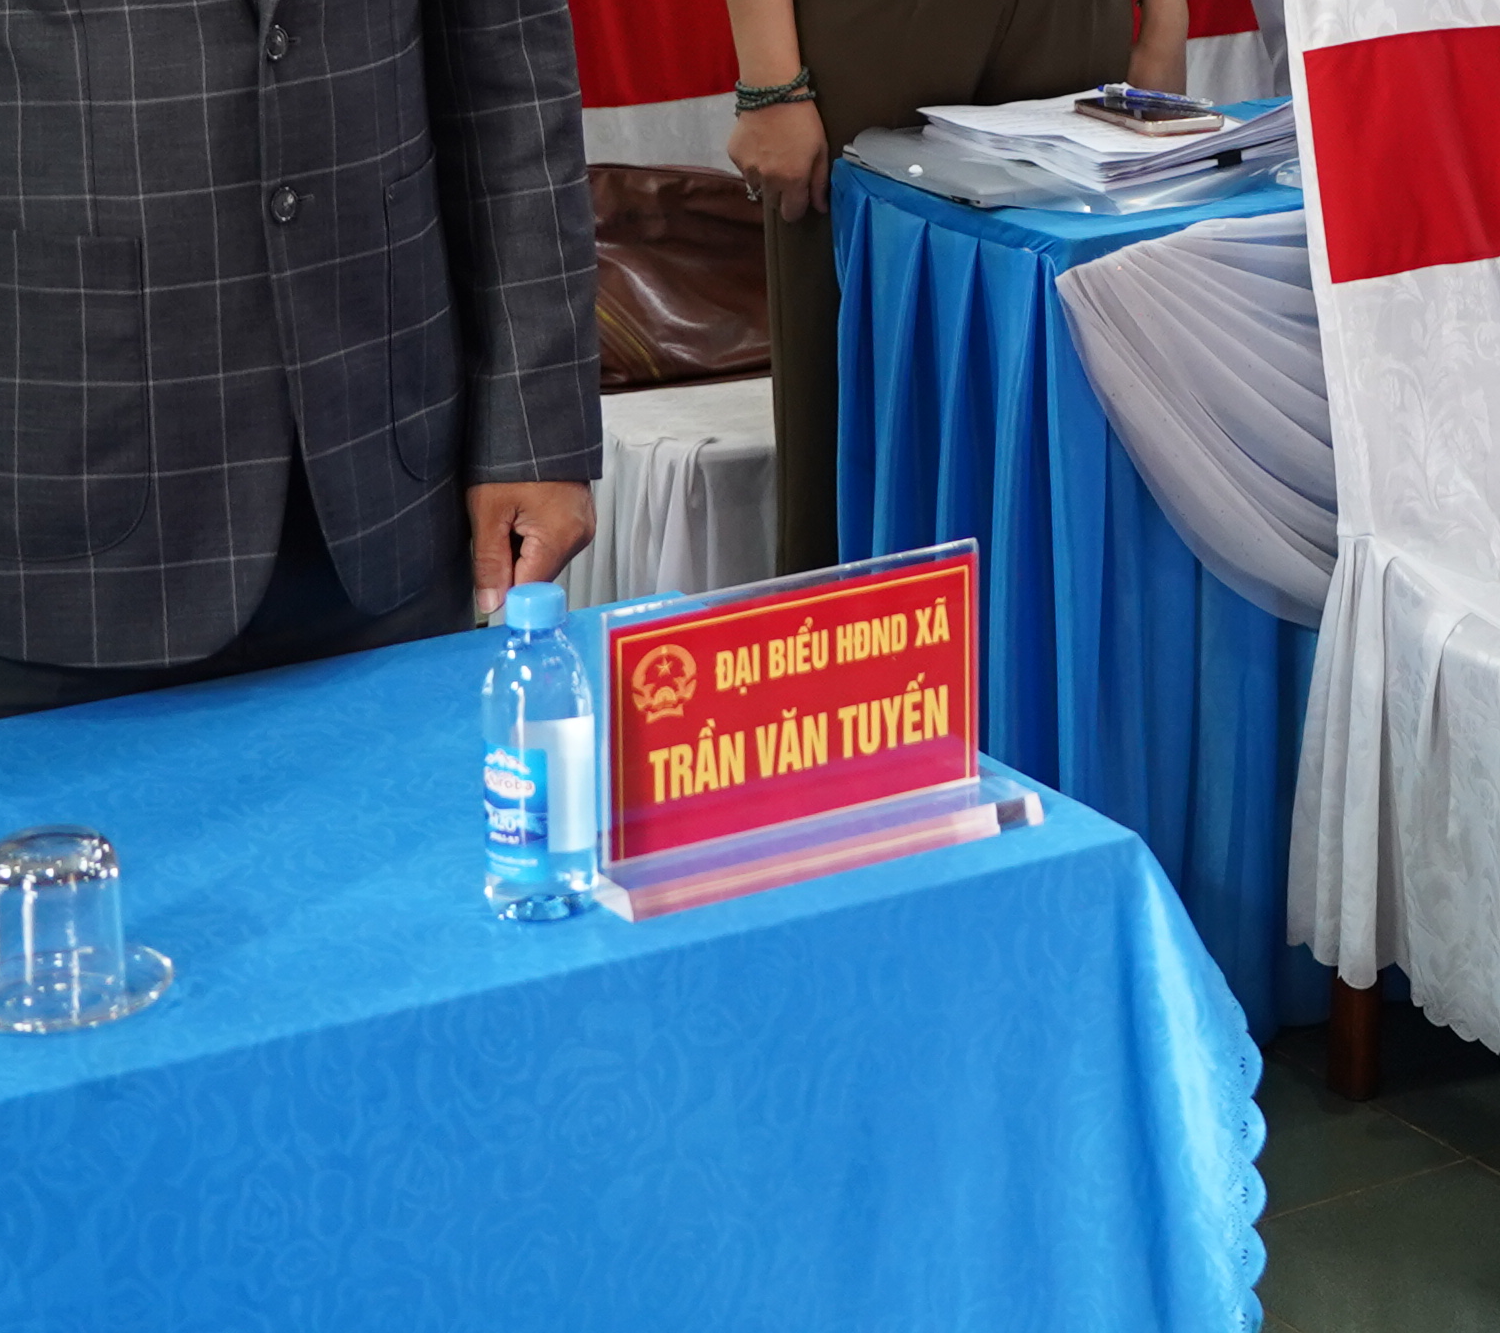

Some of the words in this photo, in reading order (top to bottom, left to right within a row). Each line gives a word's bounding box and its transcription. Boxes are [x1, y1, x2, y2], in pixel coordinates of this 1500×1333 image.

[715, 644, 760, 695] ĐẠI
[768, 616, 828, 679] BIỂU
[836, 612, 908, 664] HĐND
[914, 596, 950, 647] XÃ
[649, 718, 746, 804] TRẦN
[756, 707, 829, 778] VĂN
[837, 673, 949, 760] TUYẾN
